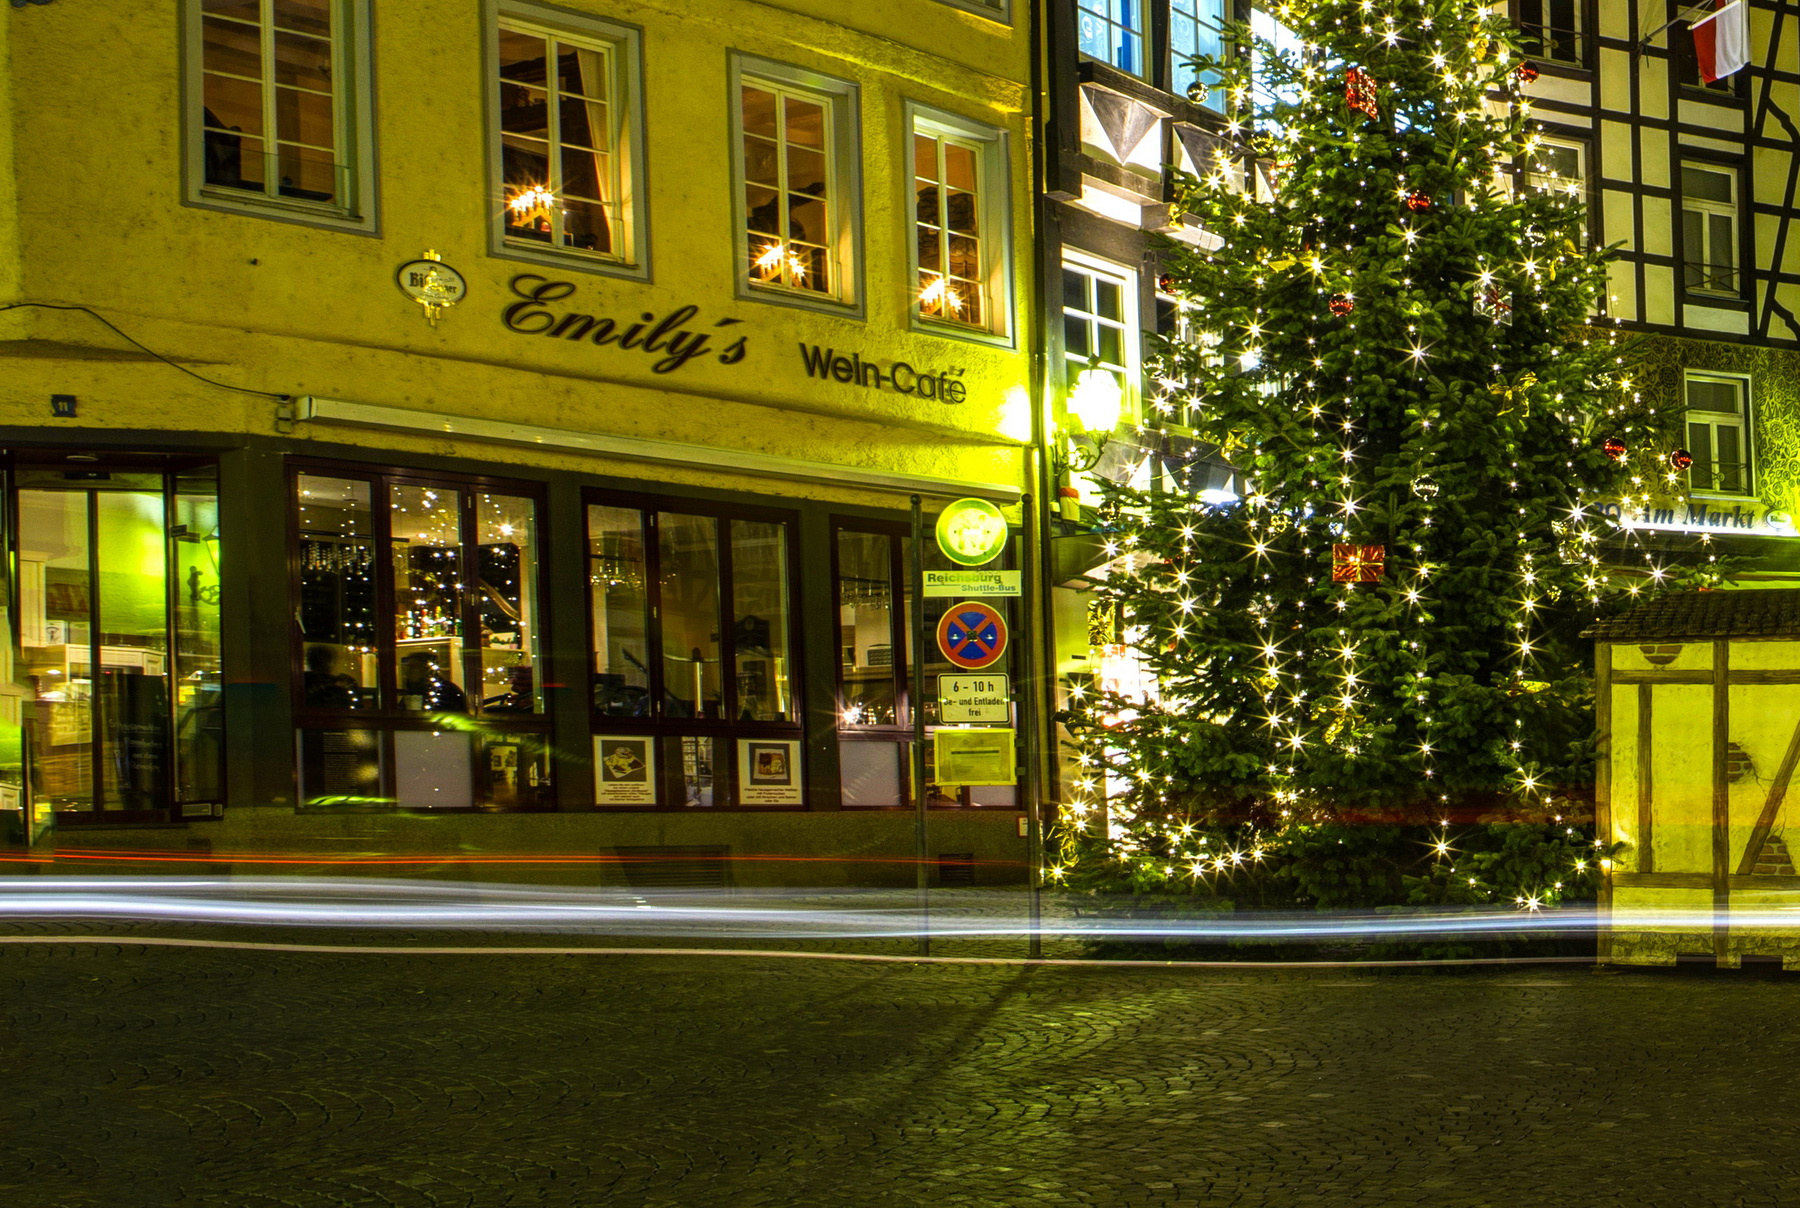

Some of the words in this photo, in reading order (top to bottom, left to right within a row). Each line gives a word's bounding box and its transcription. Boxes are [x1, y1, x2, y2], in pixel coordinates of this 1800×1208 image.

[800, 342, 967, 404] Wein-Café
[1683, 503, 1756, 529] Markt
[927, 573, 1001, 584] Reichsburg
[953, 681, 959, 692] 6
[973, 681, 985, 692] 10
[988, 681, 994, 692] h
[968, 708, 981, 716] frei
